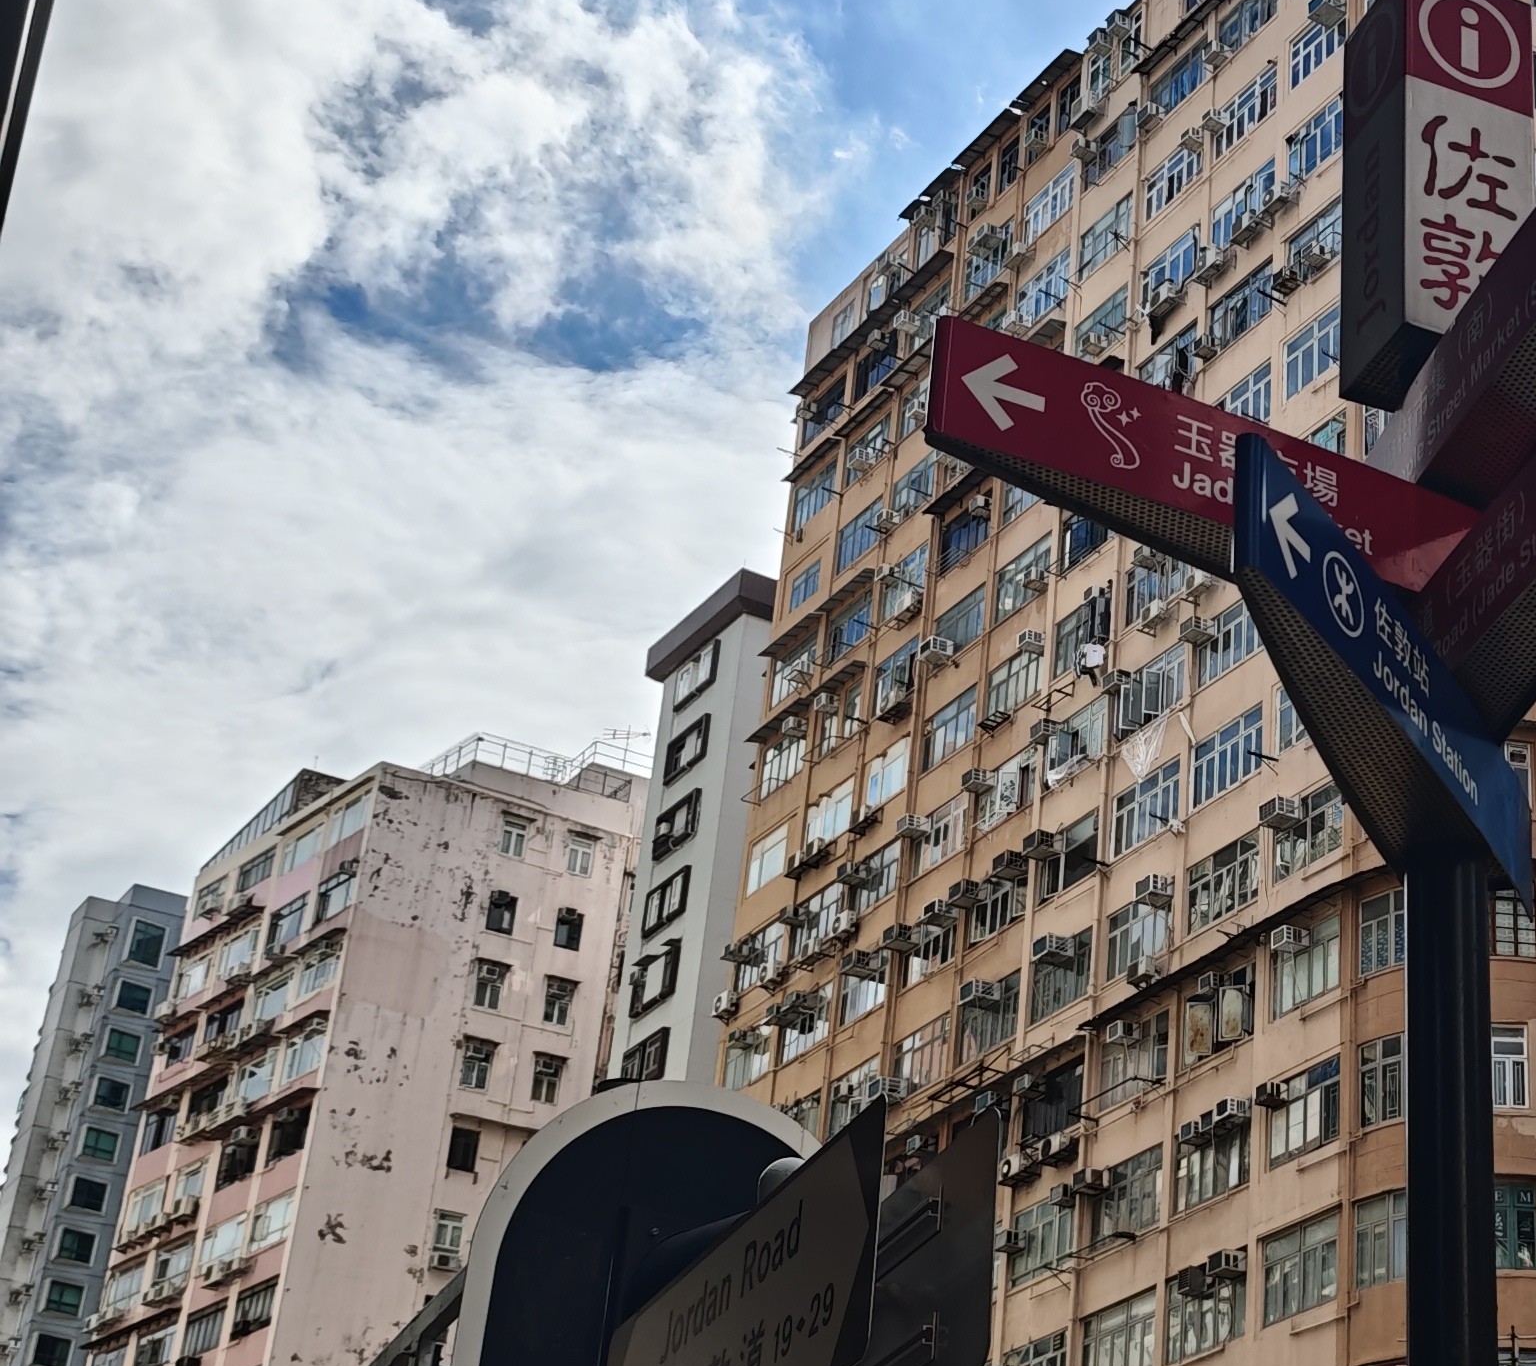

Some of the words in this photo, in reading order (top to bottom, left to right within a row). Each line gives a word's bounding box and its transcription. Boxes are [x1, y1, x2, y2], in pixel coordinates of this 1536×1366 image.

[1427, 378, 1467, 439] Street
[1470, 306, 1522, 386] Market
[1172, 461, 1234, 505] Jad
[1374, 597, 1430, 698] 佐敦站
[1373, 650, 1428, 737] Jordan
[1432, 720, 1479, 806] Station
[660, 1272, 732, 1365] Jordan
[740, 1198, 804, 1299] Road
